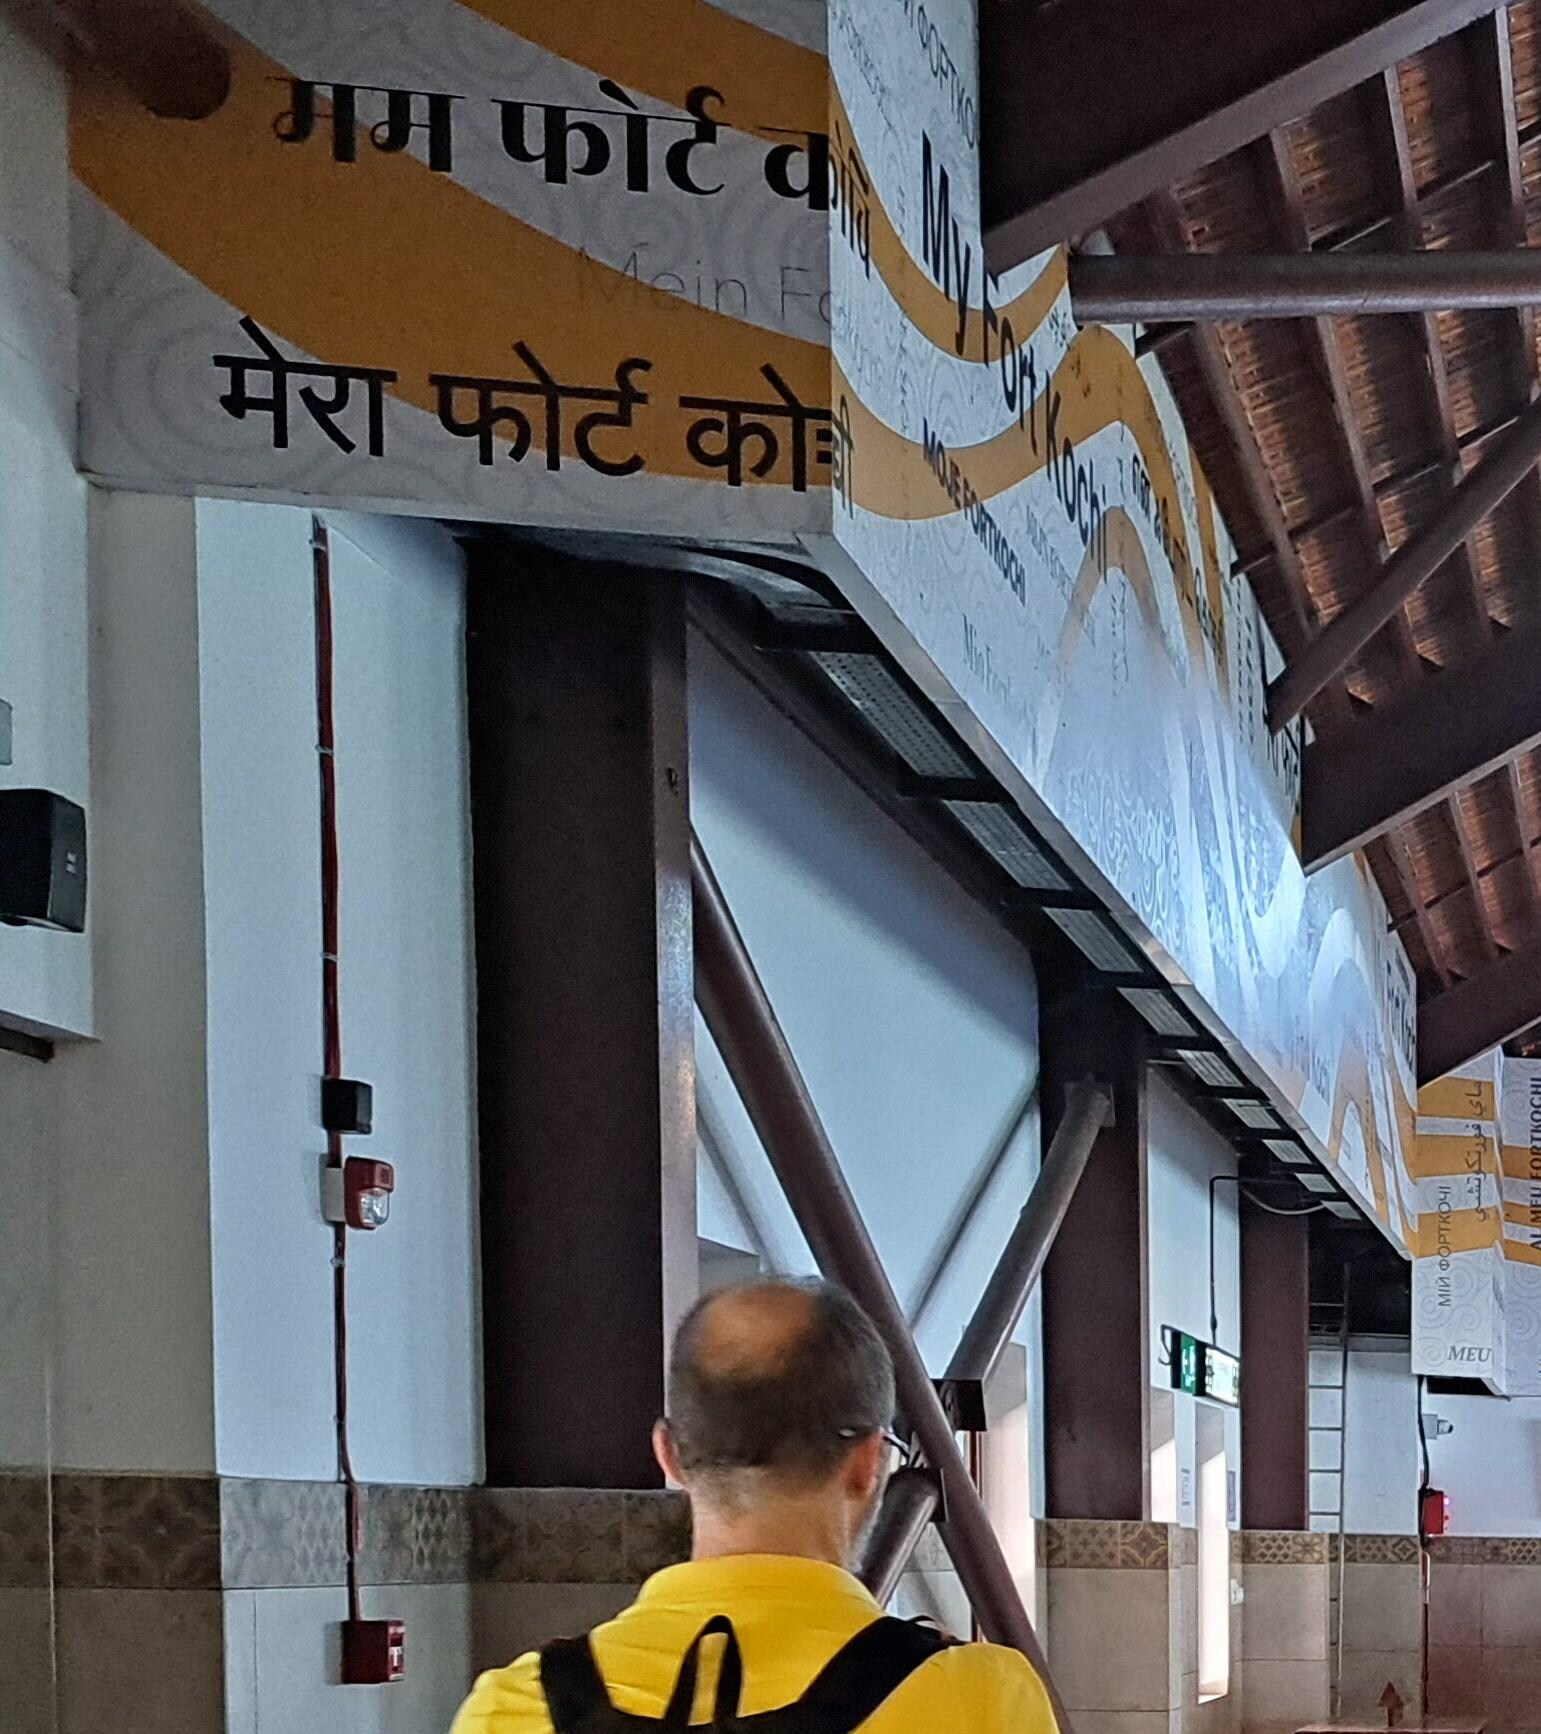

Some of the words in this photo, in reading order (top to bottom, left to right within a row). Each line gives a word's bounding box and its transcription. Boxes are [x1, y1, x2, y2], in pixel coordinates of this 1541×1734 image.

[490, 79, 730, 196] फोर्ट
[212, 316, 398, 458] मेरा
[428, 342, 651, 479] फोर्ट
[922, 129, 971, 356] My
[1045, 371, 1108, 580] Kochi
[1448, 1344, 1492, 1363] MEU
